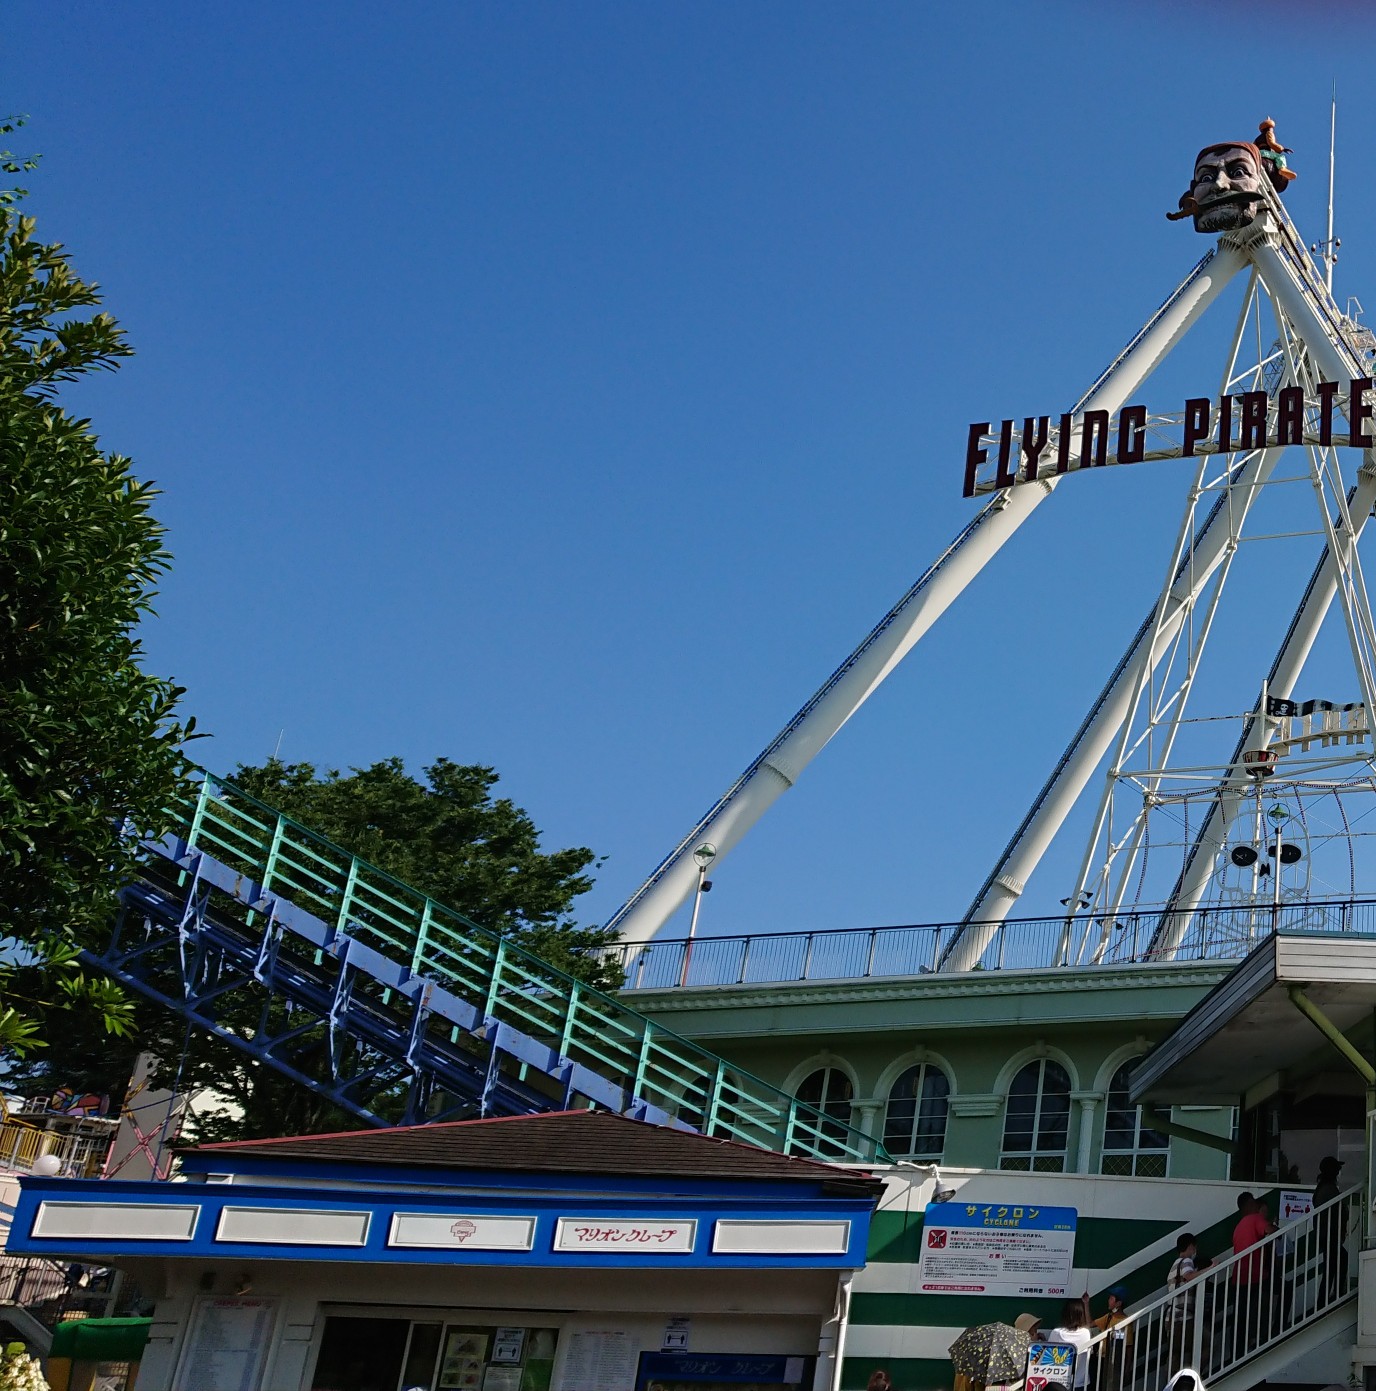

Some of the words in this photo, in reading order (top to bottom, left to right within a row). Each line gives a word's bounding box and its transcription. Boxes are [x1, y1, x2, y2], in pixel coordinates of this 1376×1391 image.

[962, 405, 1148, 498] FLYING
[966, 1205, 1040, 1219] サイクロン
[983, 1218, 1020, 1227] CYCLONE
[1033, 1367, 1067, 1375] サイクロン
